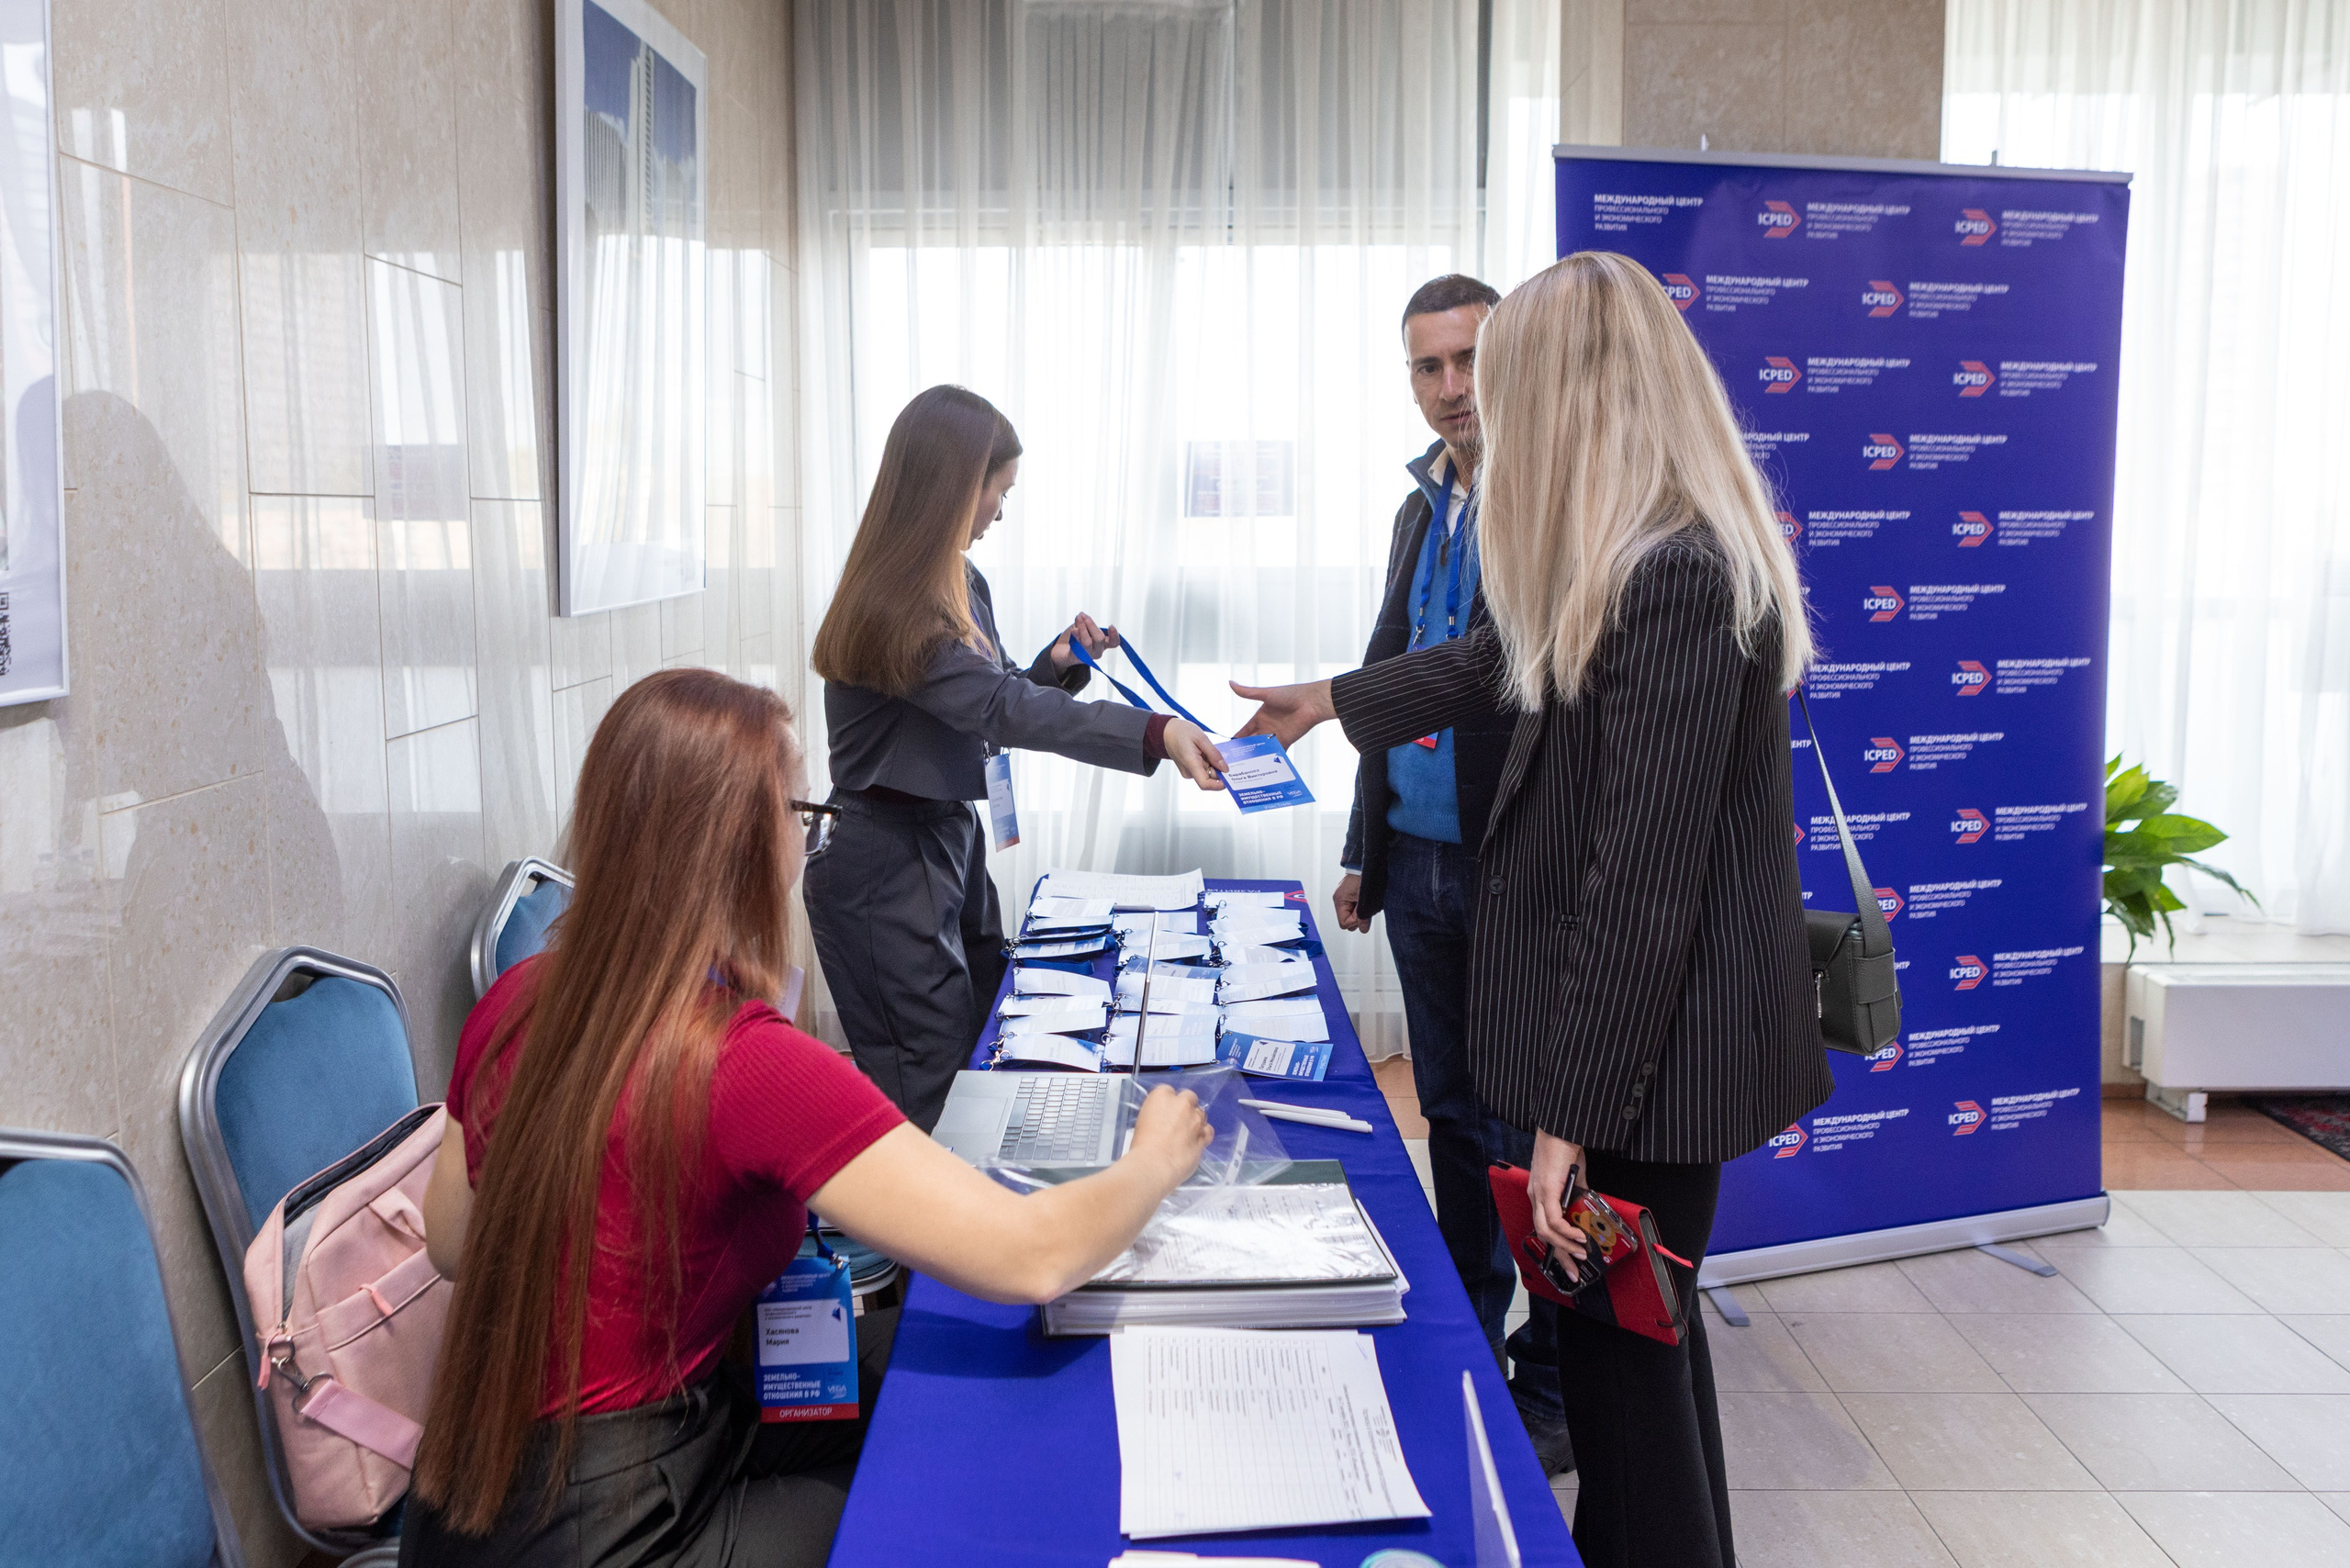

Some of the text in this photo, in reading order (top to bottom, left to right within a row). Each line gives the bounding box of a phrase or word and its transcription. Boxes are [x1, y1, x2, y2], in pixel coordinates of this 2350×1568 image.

[1594, 194, 1703, 207] МЕЖДУНАРОДНЫЙ ЦЕНТР
[1594, 204, 1670, 214] ПРОФЕССИОНАЛЬНОГО
[1807, 203, 1911, 215] МЕЖДУНАРОДНЫЙ ЦЕНТР
[1601, 213, 1663, 223] ЭКОНОМИЧЕСКОГО
[1758, 213, 1792, 226] ICPED
[1807, 213, 1879, 223] ПРОФЕССИОНАЛЬНОГО
[1594, 222, 1628, 231] РАЗВИТИЯ
[1814, 222, 1872, 231] ЭКОНОМИЧЕСКОГО
[1955, 221, 1988, 233] ICPED
[1807, 231, 1839, 239] РАЗВИТИЯ
[1706, 275, 1809, 288] МЕЖДУНАРОДНЫЙ ЦЕНТР
[1706, 285, 1777, 296] ПРОФЕССИОНАЛЬНОГО
[1909, 282, 2009, 295] МЕЖДУНАРОДНЫЙ ЦЕНТР
[1712, 294, 1770, 304] ЭКОНОМИЧЕСКОГО
[1862, 293, 1896, 305] ICPED
[1705, 303, 1738, 312] РАЗВИТИЯ
[1808, 357, 1911, 369] МЕЖДУНАРОДНЫЙ ЦЕНТР
[1759, 369, 1793, 381] ICPED
[1808, 367, 1879, 376] ПРОФЕССИОНАЛЬНОГО
[1814, 376, 1873, 385] ЭКОНОМИЧЕСКОГО
[1953, 373, 1987, 385] ICPED
[1784, 432, 1810, 442] ЦЕНТР
[1909, 434, 2007, 445] МЕЖДУНАРОДНЫЙ ЦЕНТР
[1863, 446, 1897, 458] ICPED
[1809, 509, 1912, 521] МЕЖДУНАРОДНЫЙ ЦЕНТР
[1953, 523, 1986, 535] ICPED
[1910, 583, 2005, 595] МЕЖДУНАРОДНЫЙ ЦЕНТР
[1863, 598, 1897, 610] ICPED
[1810, 661, 1912, 674] МЕЖДУНАРОДНЫЙ ЦЕНТР
[1810, 673, 1880, 682] ПРОФЕССИОНАЛЬНОГО
[1952, 672, 1984, 684] ICPED
[1817, 681, 1874, 690] ЭКОНОМИЧЕСКОГО
[1791, 739, 1812, 749] ЕНТР
[1910, 732, 2003, 745] МЕЖДУНАРОДНЫЙ ЦЕНТР
[1864, 748, 1897, 761] ICPED
[1810, 812, 1911, 826] МЕЖДАРОДНЫЙ ЦЕНТР
[1951, 820, 1983, 833] ICPED
[1811, 842, 1843, 851] РАЗВИТИЯ
[1910, 879, 2002, 895] МЕЖДУНАРОДНЫЙ ЦЕНТР
[1908, 910, 1937, 919] РАЗВИТИЯ
[1950, 966, 1981, 979] ICPED
[1909, 1024, 2000, 1043] МЕЖДУНАРОДНЫЙ ЦЕНТР
[1908, 1057, 1936, 1067] РАЗВИТИЯ
[1813, 1109, 1910, 1128] МЕЖДУНАРОДНЫЙ ЦЕНТР
[1948, 1111, 1979, 1125] ICPED
[1769, 1133, 1800, 1148] ICPED
[1813, 1142, 1844, 1152] РАЗВИТИЯ
[766, 1338, 789, 1347] Мария
[763, 1372, 801, 1382] ЗЕМЕЛЬНО-
[763, 1380, 821, 1391] ИМУЩЕСТВЕННЫЕ
[763, 1390, 803, 1400] ОТНОШЕНИЯ
[779, 1407, 833, 1418] ОРГАНИЗАТОР
